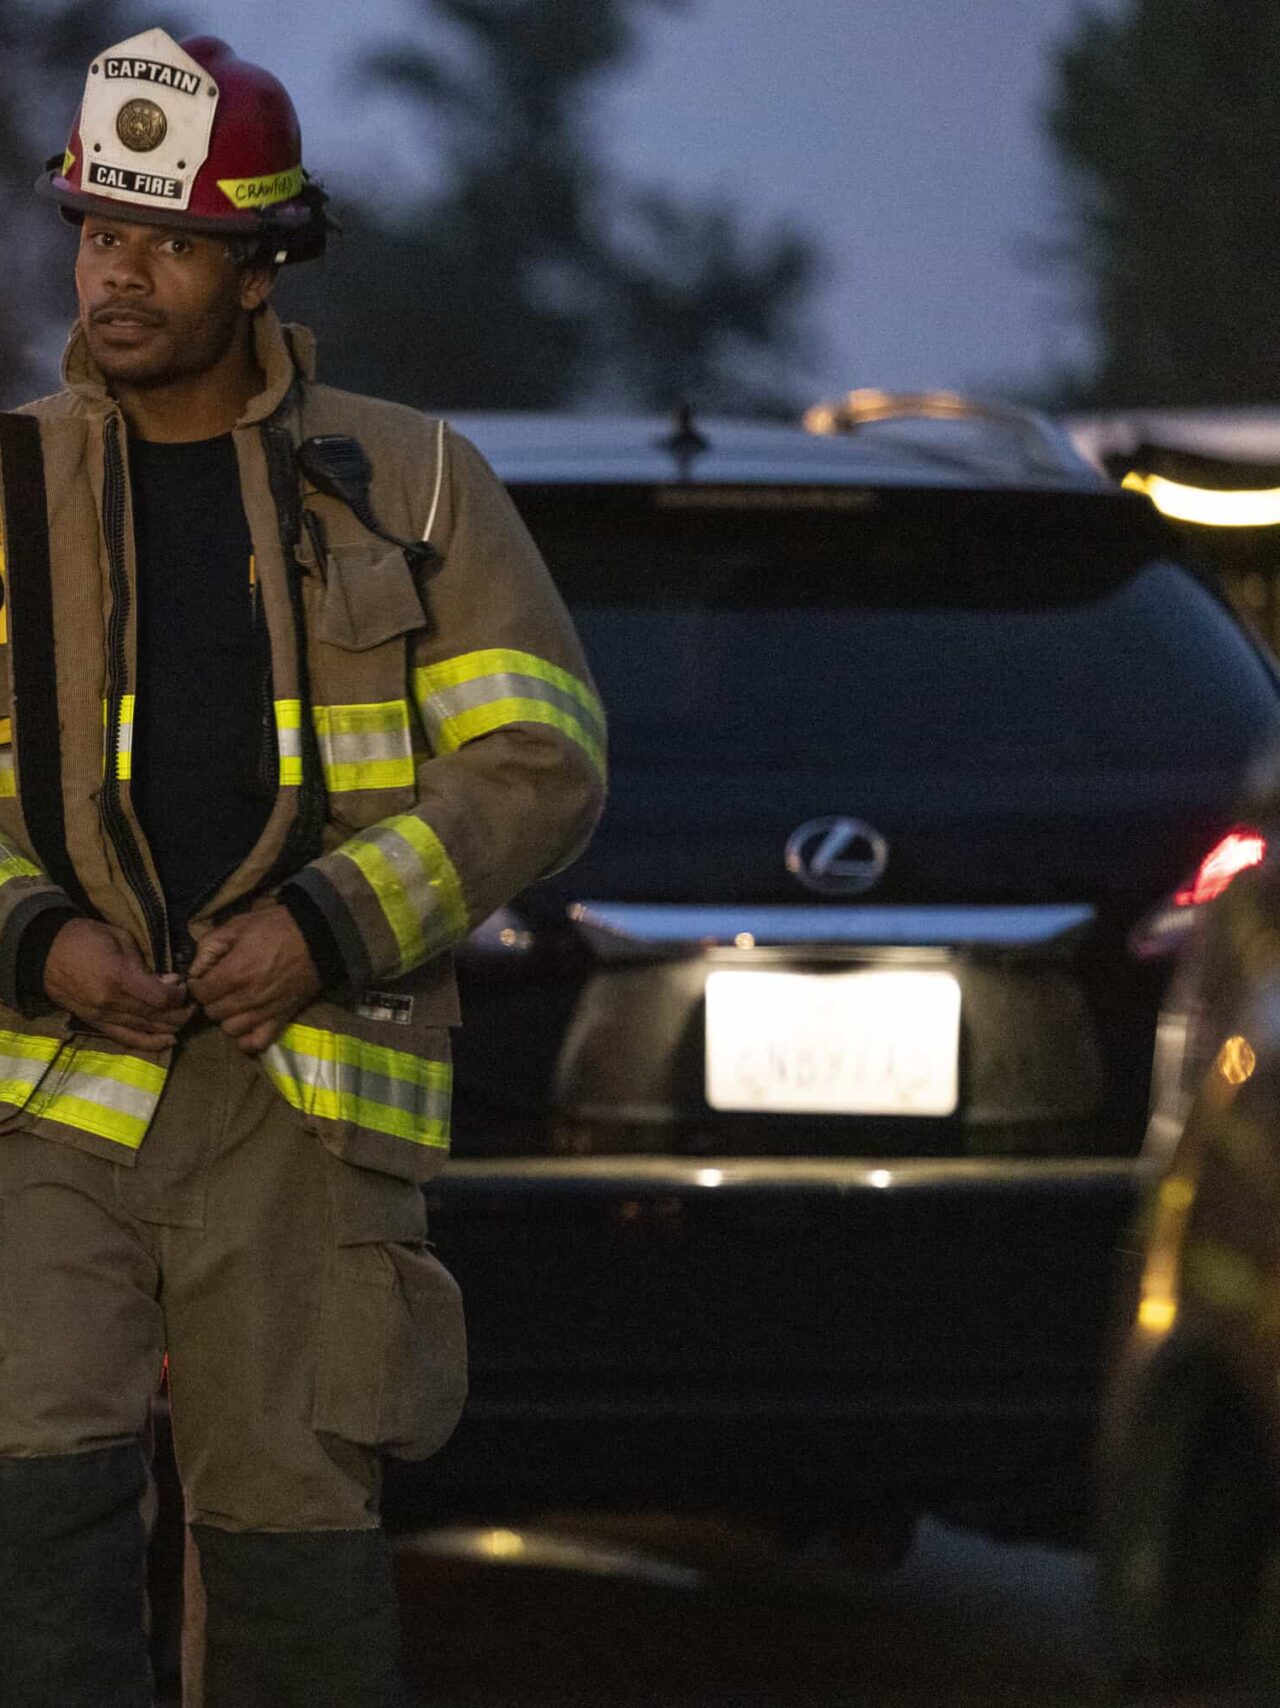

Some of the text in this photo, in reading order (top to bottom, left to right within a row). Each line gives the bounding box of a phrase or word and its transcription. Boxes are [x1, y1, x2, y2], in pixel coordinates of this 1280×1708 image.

[107, 60, 197, 93] CAPTAIN
[96, 167, 176, 197] CAL FIRE
